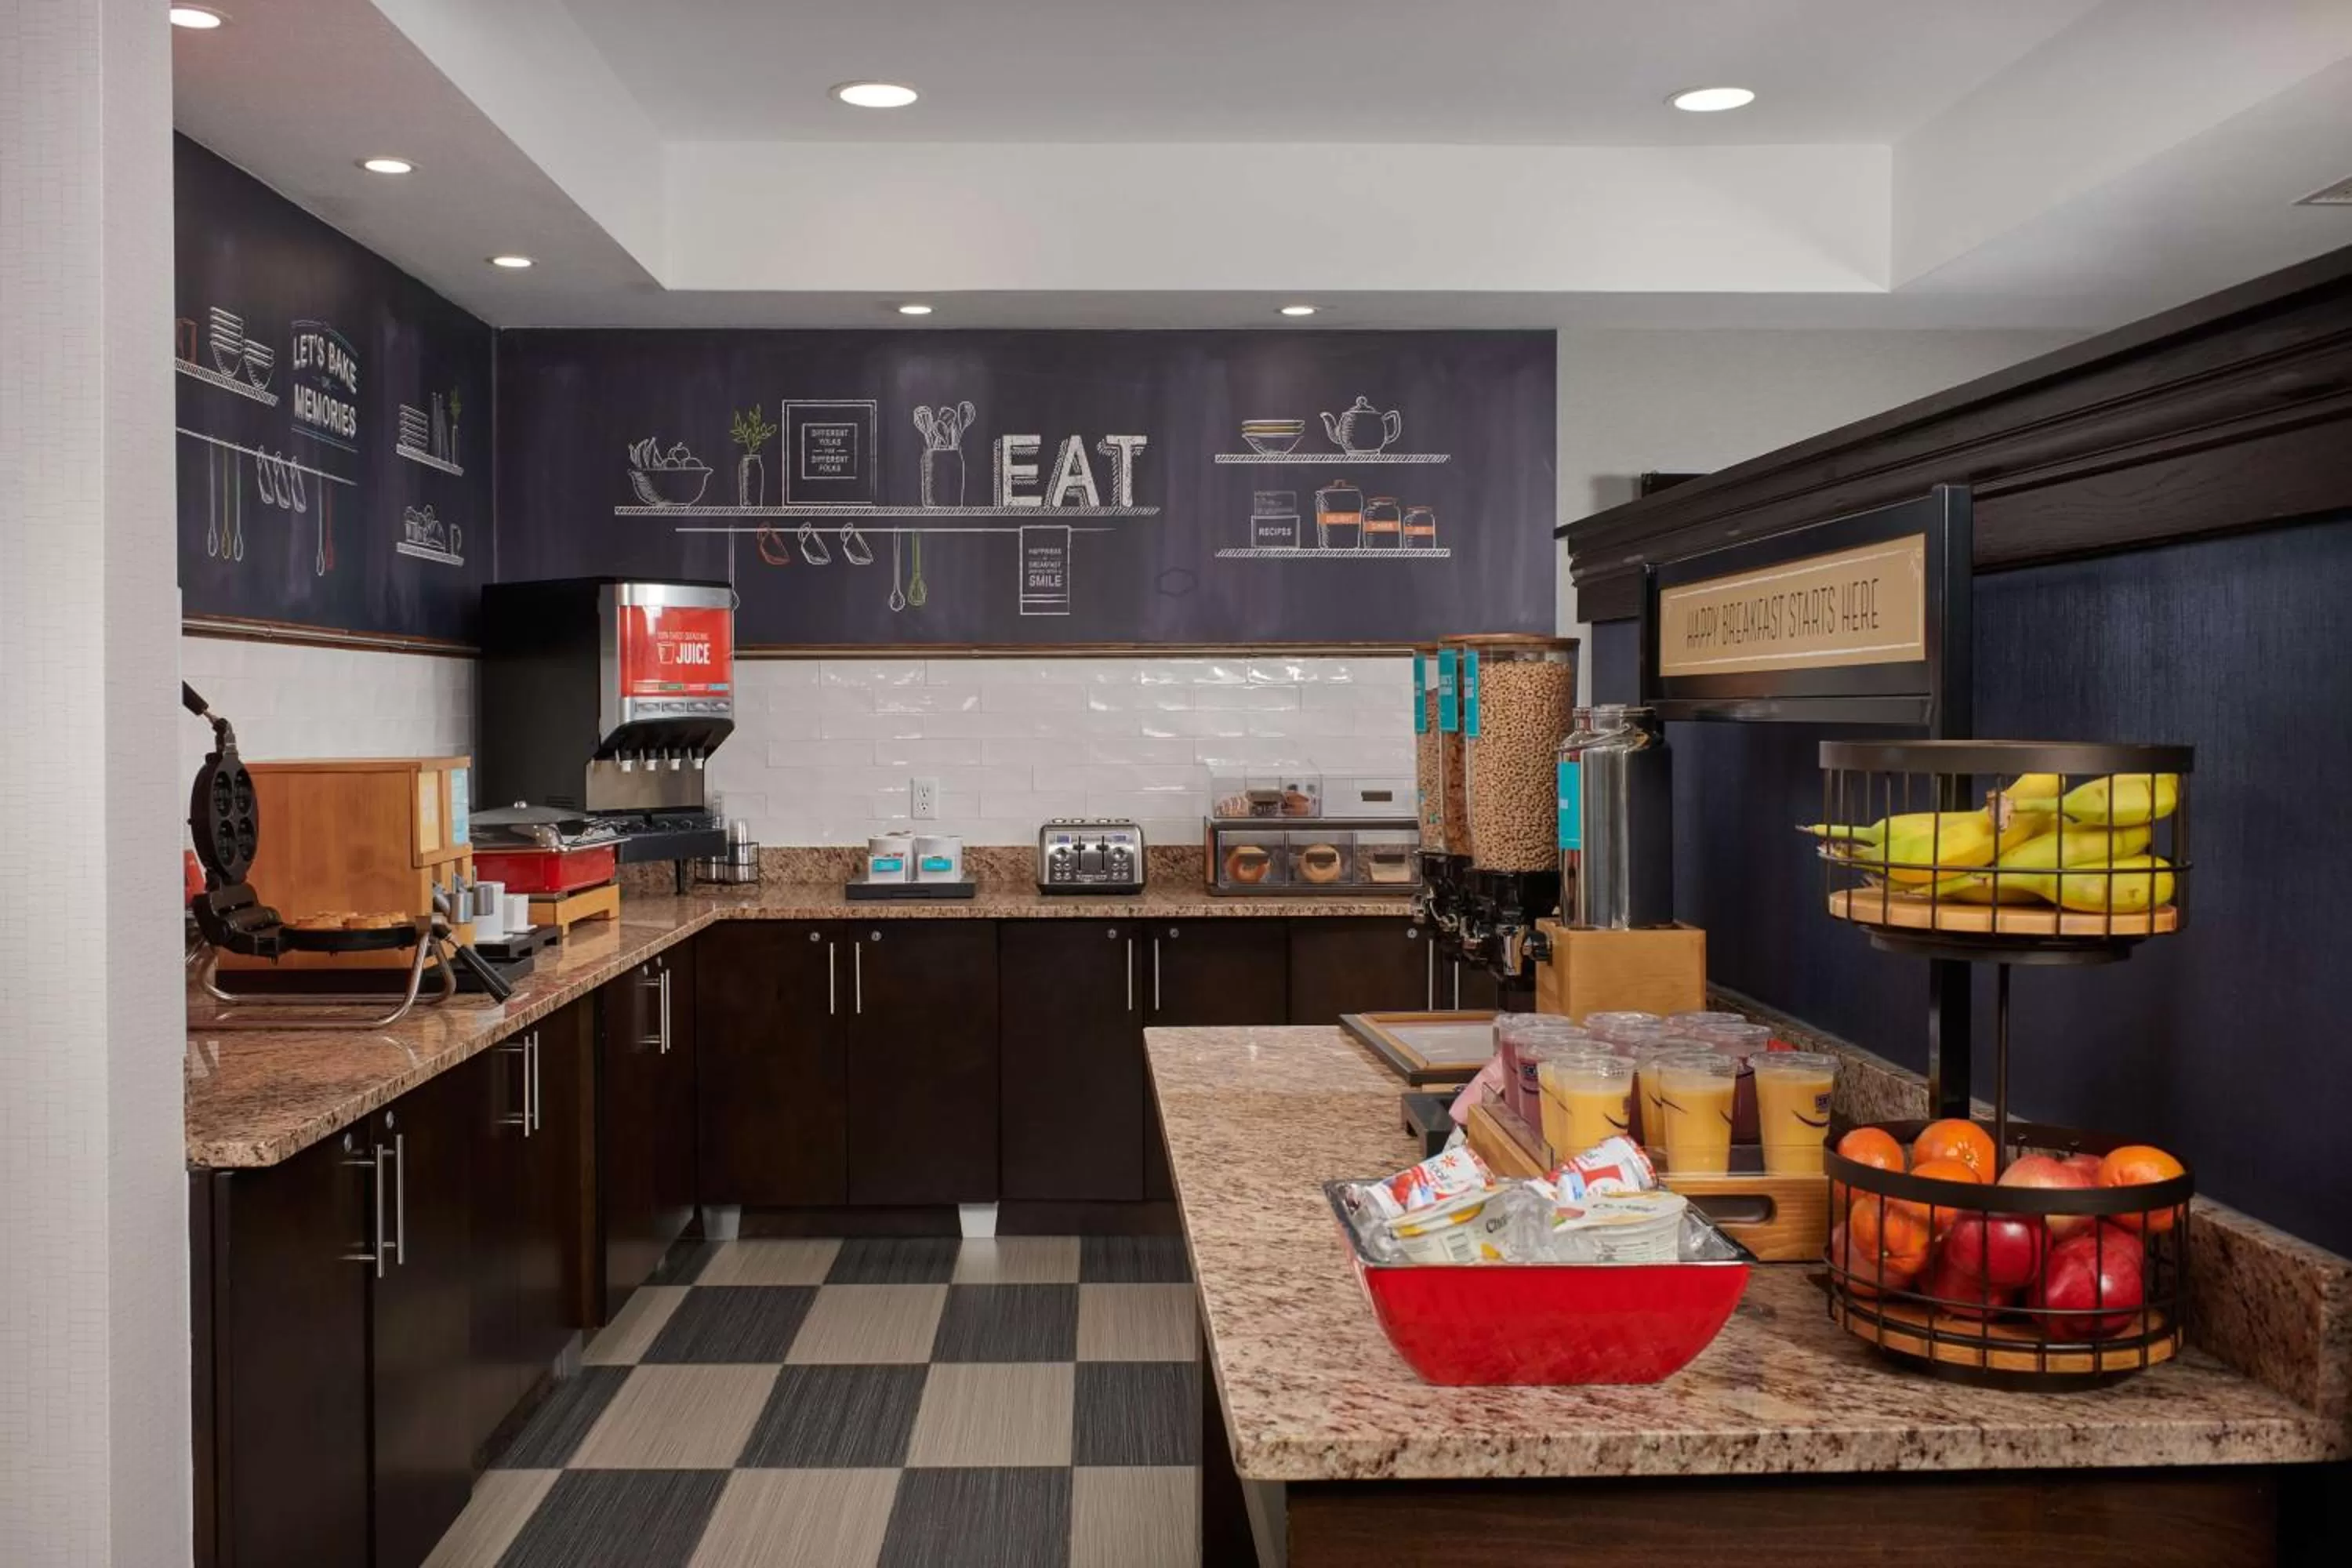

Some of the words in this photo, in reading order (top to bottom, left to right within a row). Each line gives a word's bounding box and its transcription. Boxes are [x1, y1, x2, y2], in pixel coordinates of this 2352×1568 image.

[292, 332, 325, 370] LET'S
[328, 341, 357, 394] BAKE
[293, 382, 357, 439] MEMORIES
[994, 434, 1147, 509] EAT
[1258, 526, 1292, 536] RECIPES
[1028, 575, 1062, 587] SMILE
[1686, 605, 1719, 649] HAPPY
[1722, 593, 1784, 646] BREAKFAST
[1788, 586, 1836, 639] STARTS
[1842, 577, 1880, 633] HERE
[676, 641, 712, 666] JUICE
